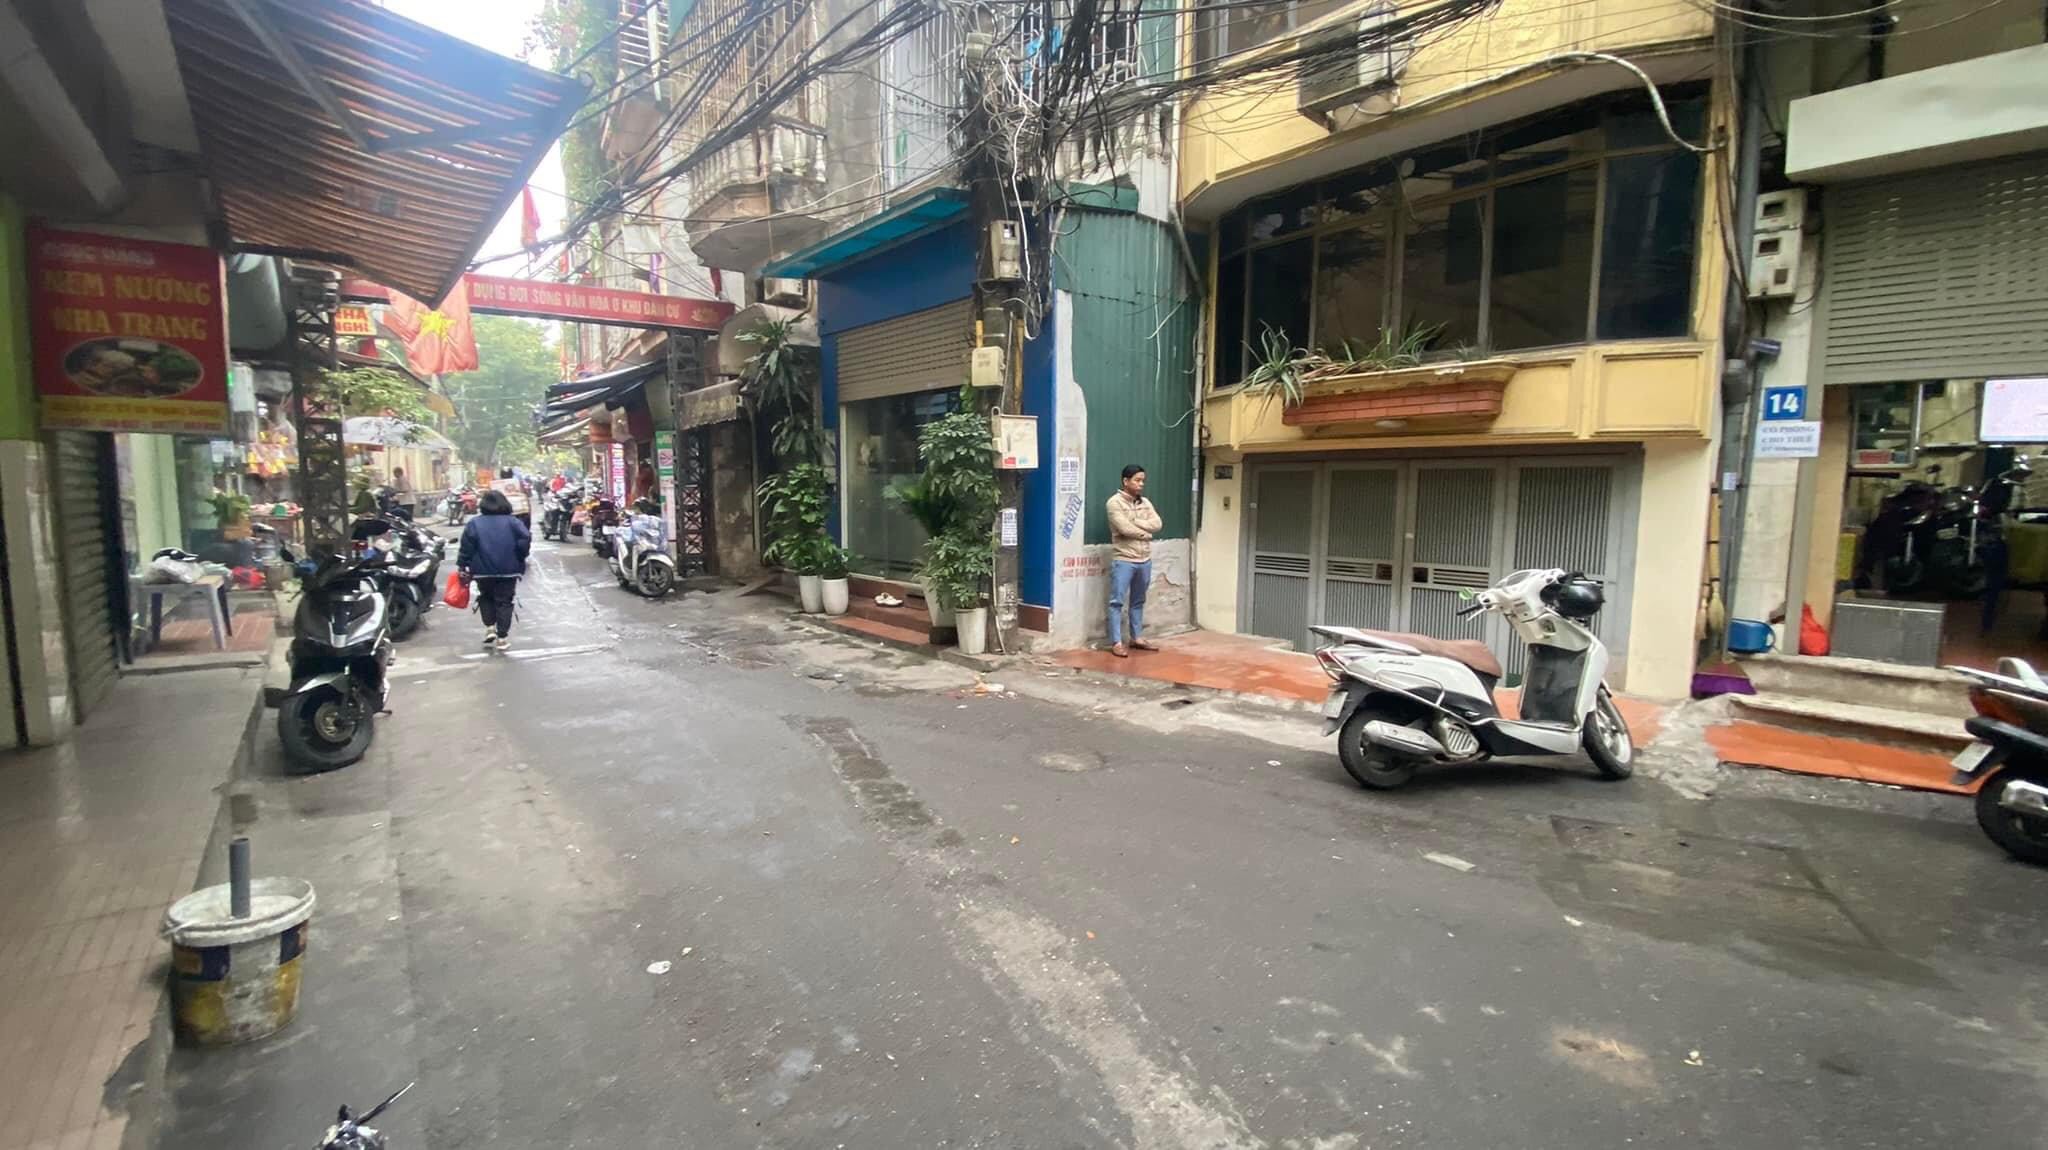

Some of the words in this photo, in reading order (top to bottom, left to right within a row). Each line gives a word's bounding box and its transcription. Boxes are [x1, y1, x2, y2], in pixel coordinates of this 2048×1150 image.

[622, 297, 641, 315] KHU
[118, 311, 207, 340] TRANG
[1770, 393, 1799, 413] 14
